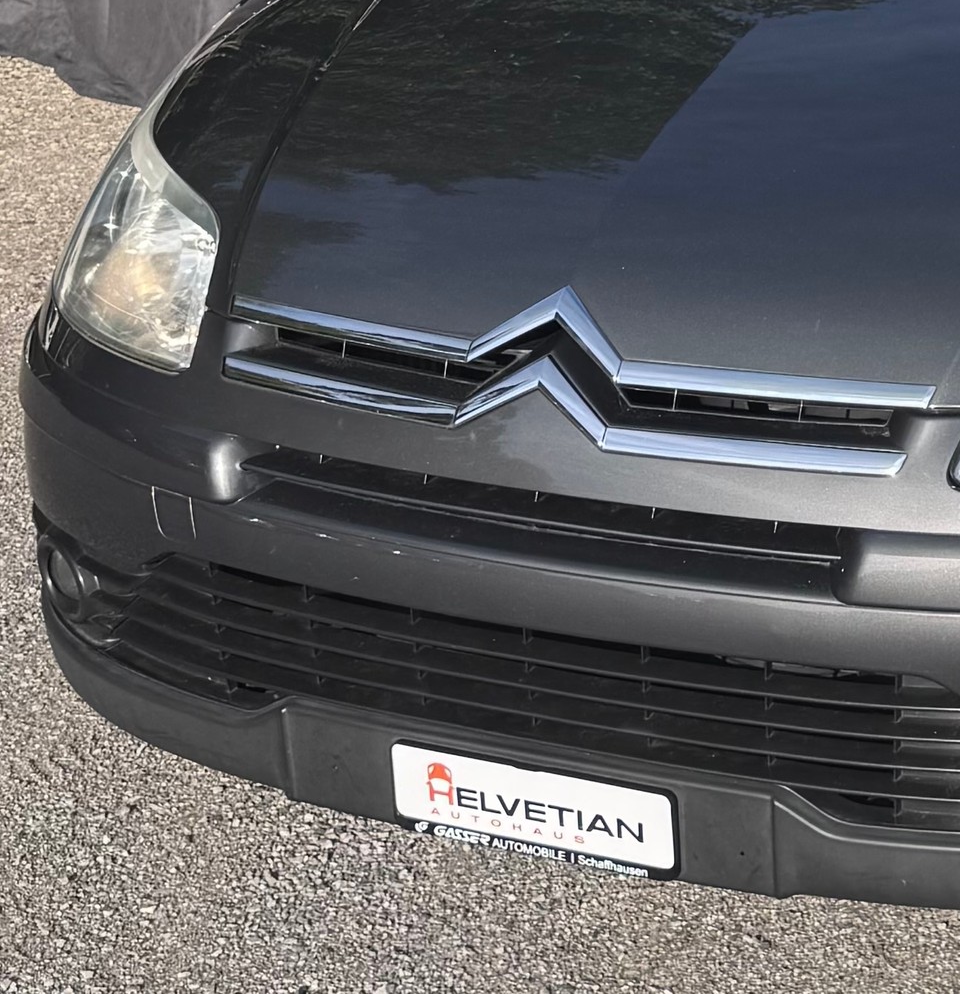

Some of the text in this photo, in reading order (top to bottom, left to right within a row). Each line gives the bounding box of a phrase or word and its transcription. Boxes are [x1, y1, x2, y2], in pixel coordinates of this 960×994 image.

[426, 778, 644, 843] HELVETIAN
[431, 808, 585, 844] AUTOHAUS
[433, 825, 491, 846] GASSER
[492, 837, 567, 862] AUTOMOBILE
[577, 854, 649, 878] Schaffhausen
